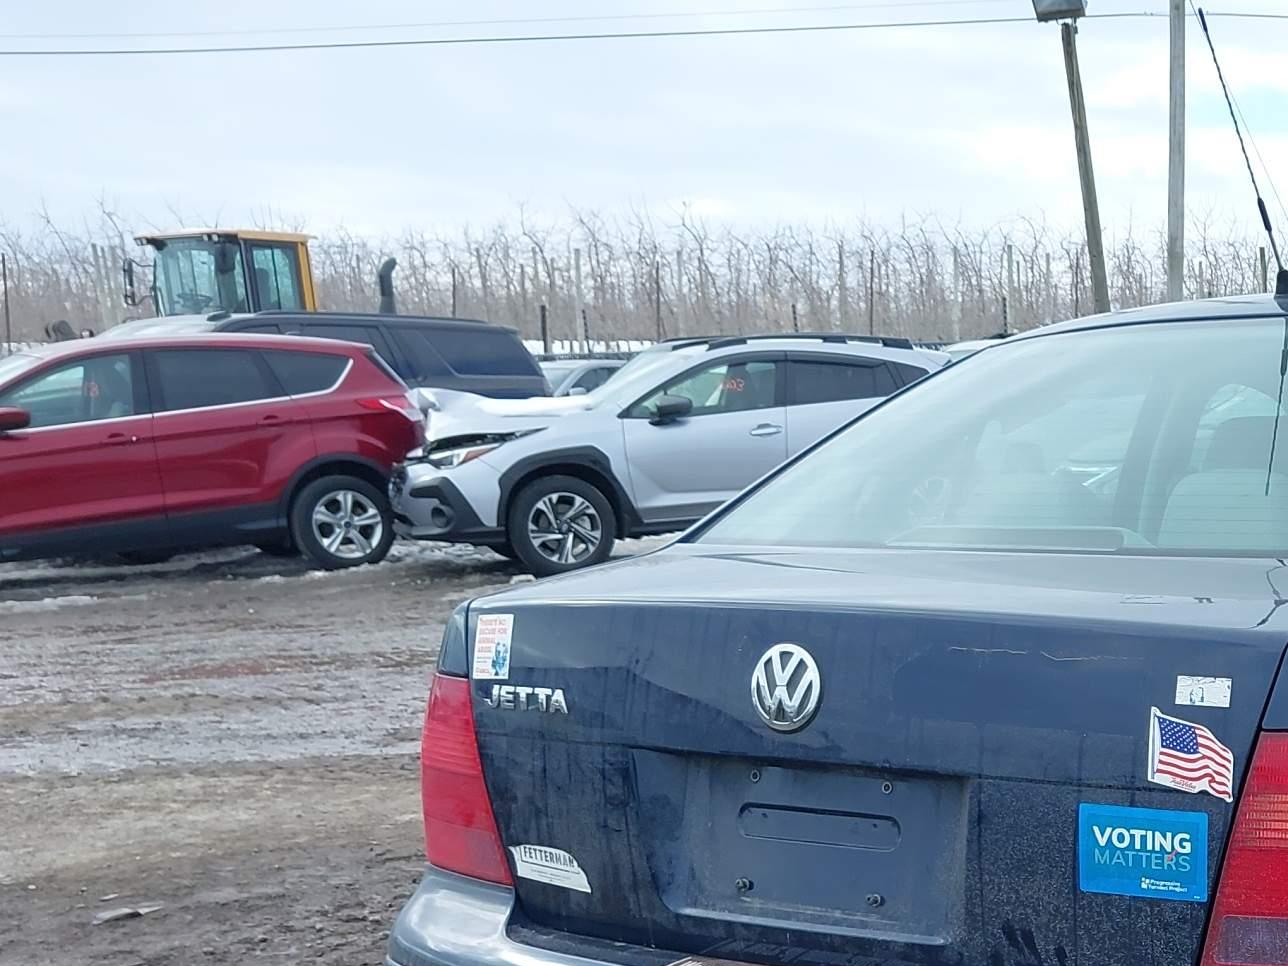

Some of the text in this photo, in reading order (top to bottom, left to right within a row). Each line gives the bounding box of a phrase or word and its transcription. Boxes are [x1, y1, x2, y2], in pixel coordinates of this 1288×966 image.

[483, 684, 568, 714] JETTA
[1092, 825, 1191, 854] VOTING
[523, 846, 575, 868] FETTERMAN
[1094, 847, 1191, 872] MATTERS
